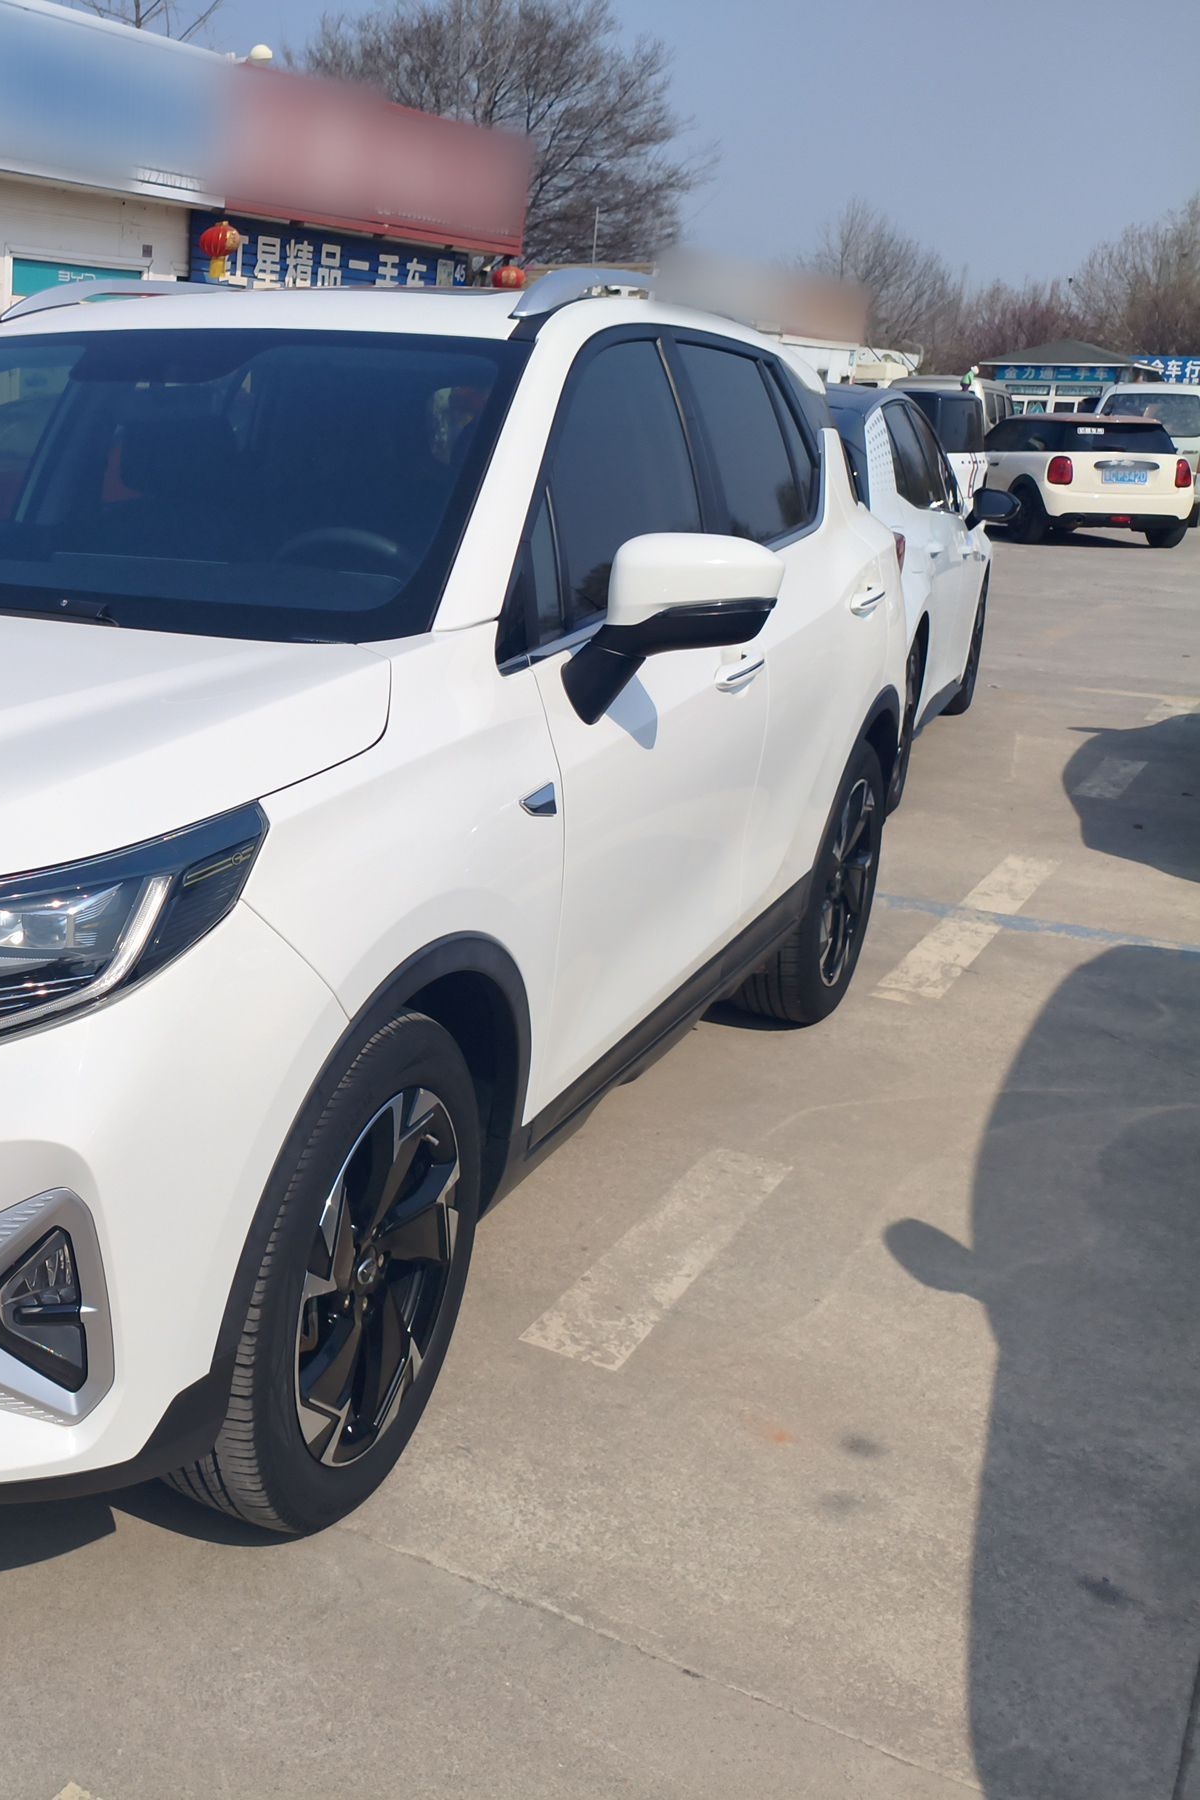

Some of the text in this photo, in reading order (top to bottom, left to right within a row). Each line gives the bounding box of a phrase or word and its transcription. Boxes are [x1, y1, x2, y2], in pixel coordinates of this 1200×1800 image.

[1004, 366, 1109, 380] 金力通二手车
